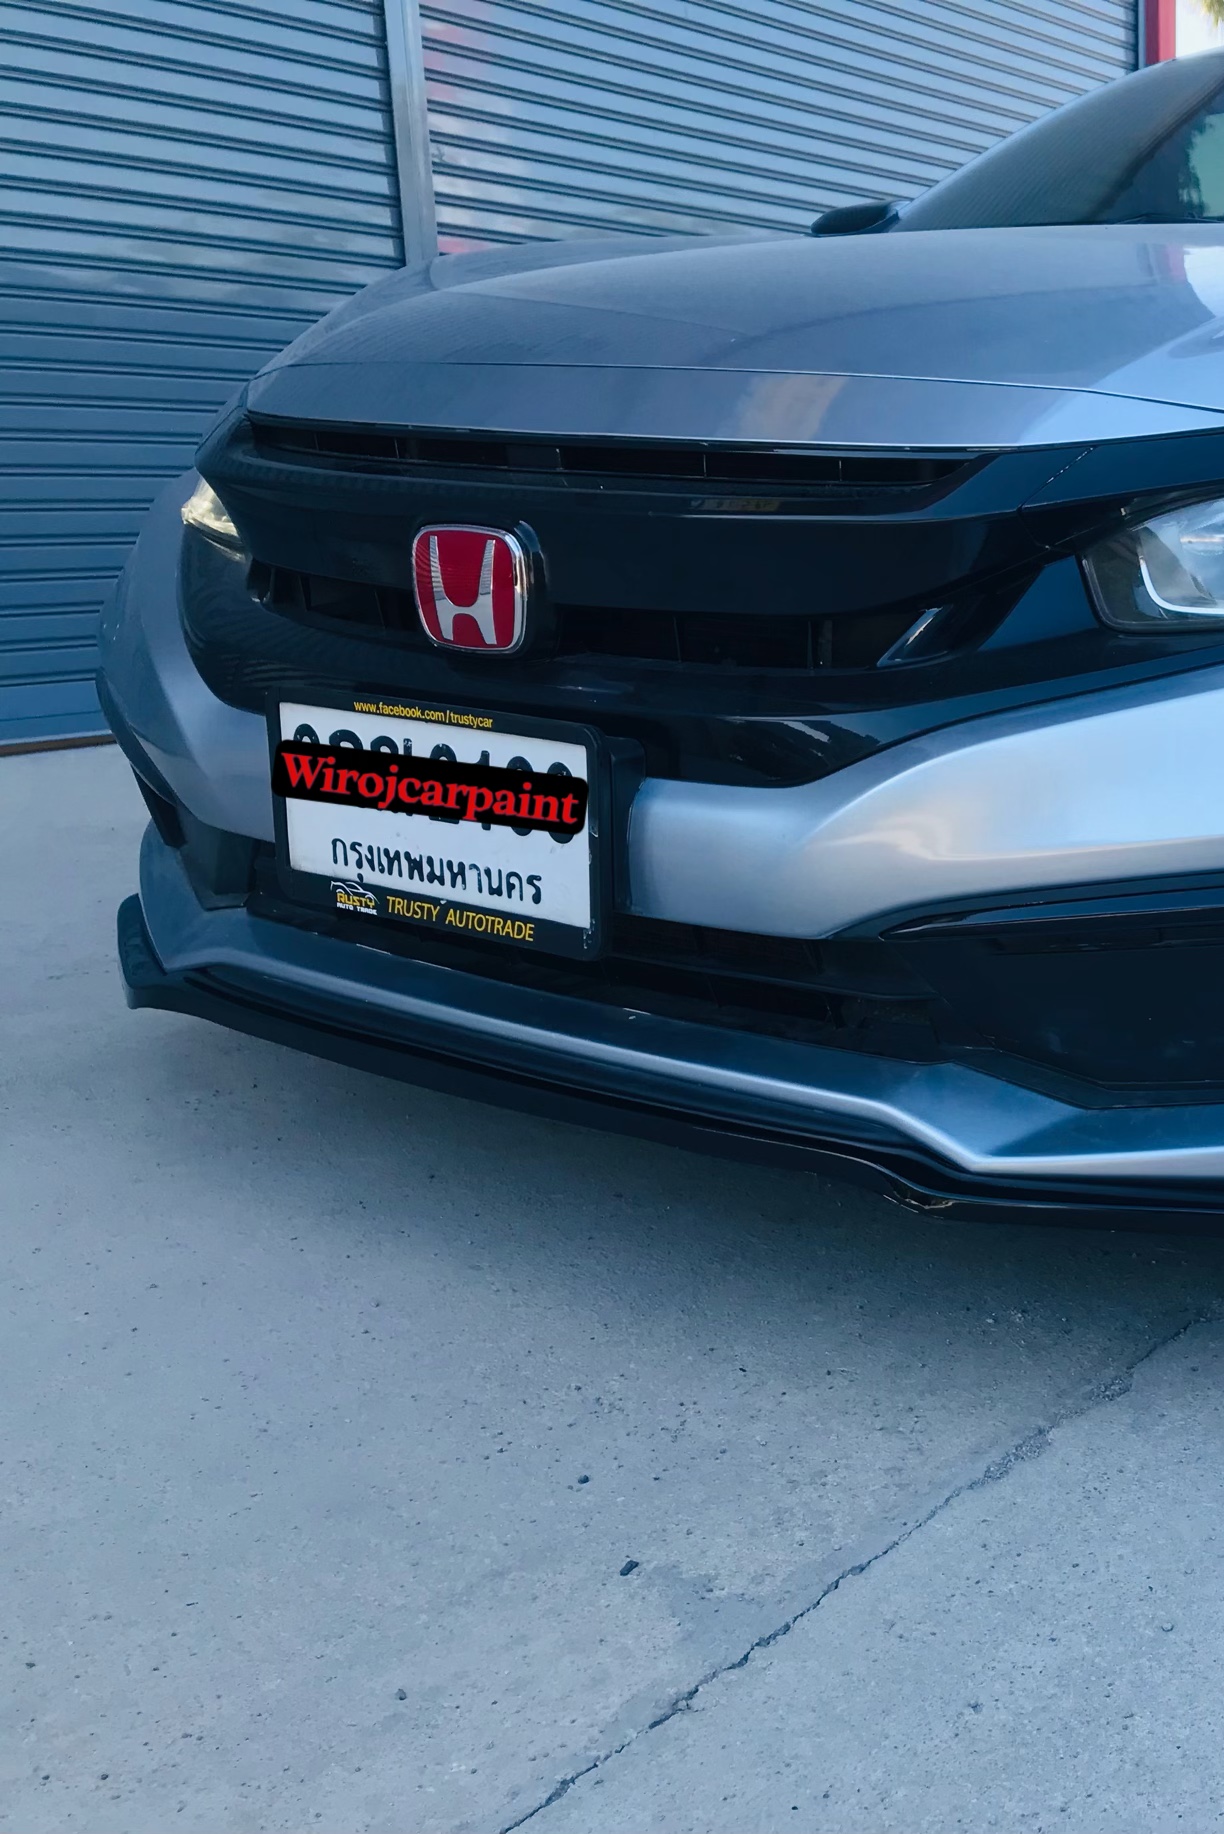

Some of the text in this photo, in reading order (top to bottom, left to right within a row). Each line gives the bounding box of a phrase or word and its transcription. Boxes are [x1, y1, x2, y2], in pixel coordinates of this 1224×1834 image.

[429, 535, 498, 645] H
[353, 701, 494, 729] www.facebook.com/trustycar
[331, 838, 542, 905] กรุงเทพมหานคร
[386, 895, 535, 942] TRUSTY AUTOTRADE
